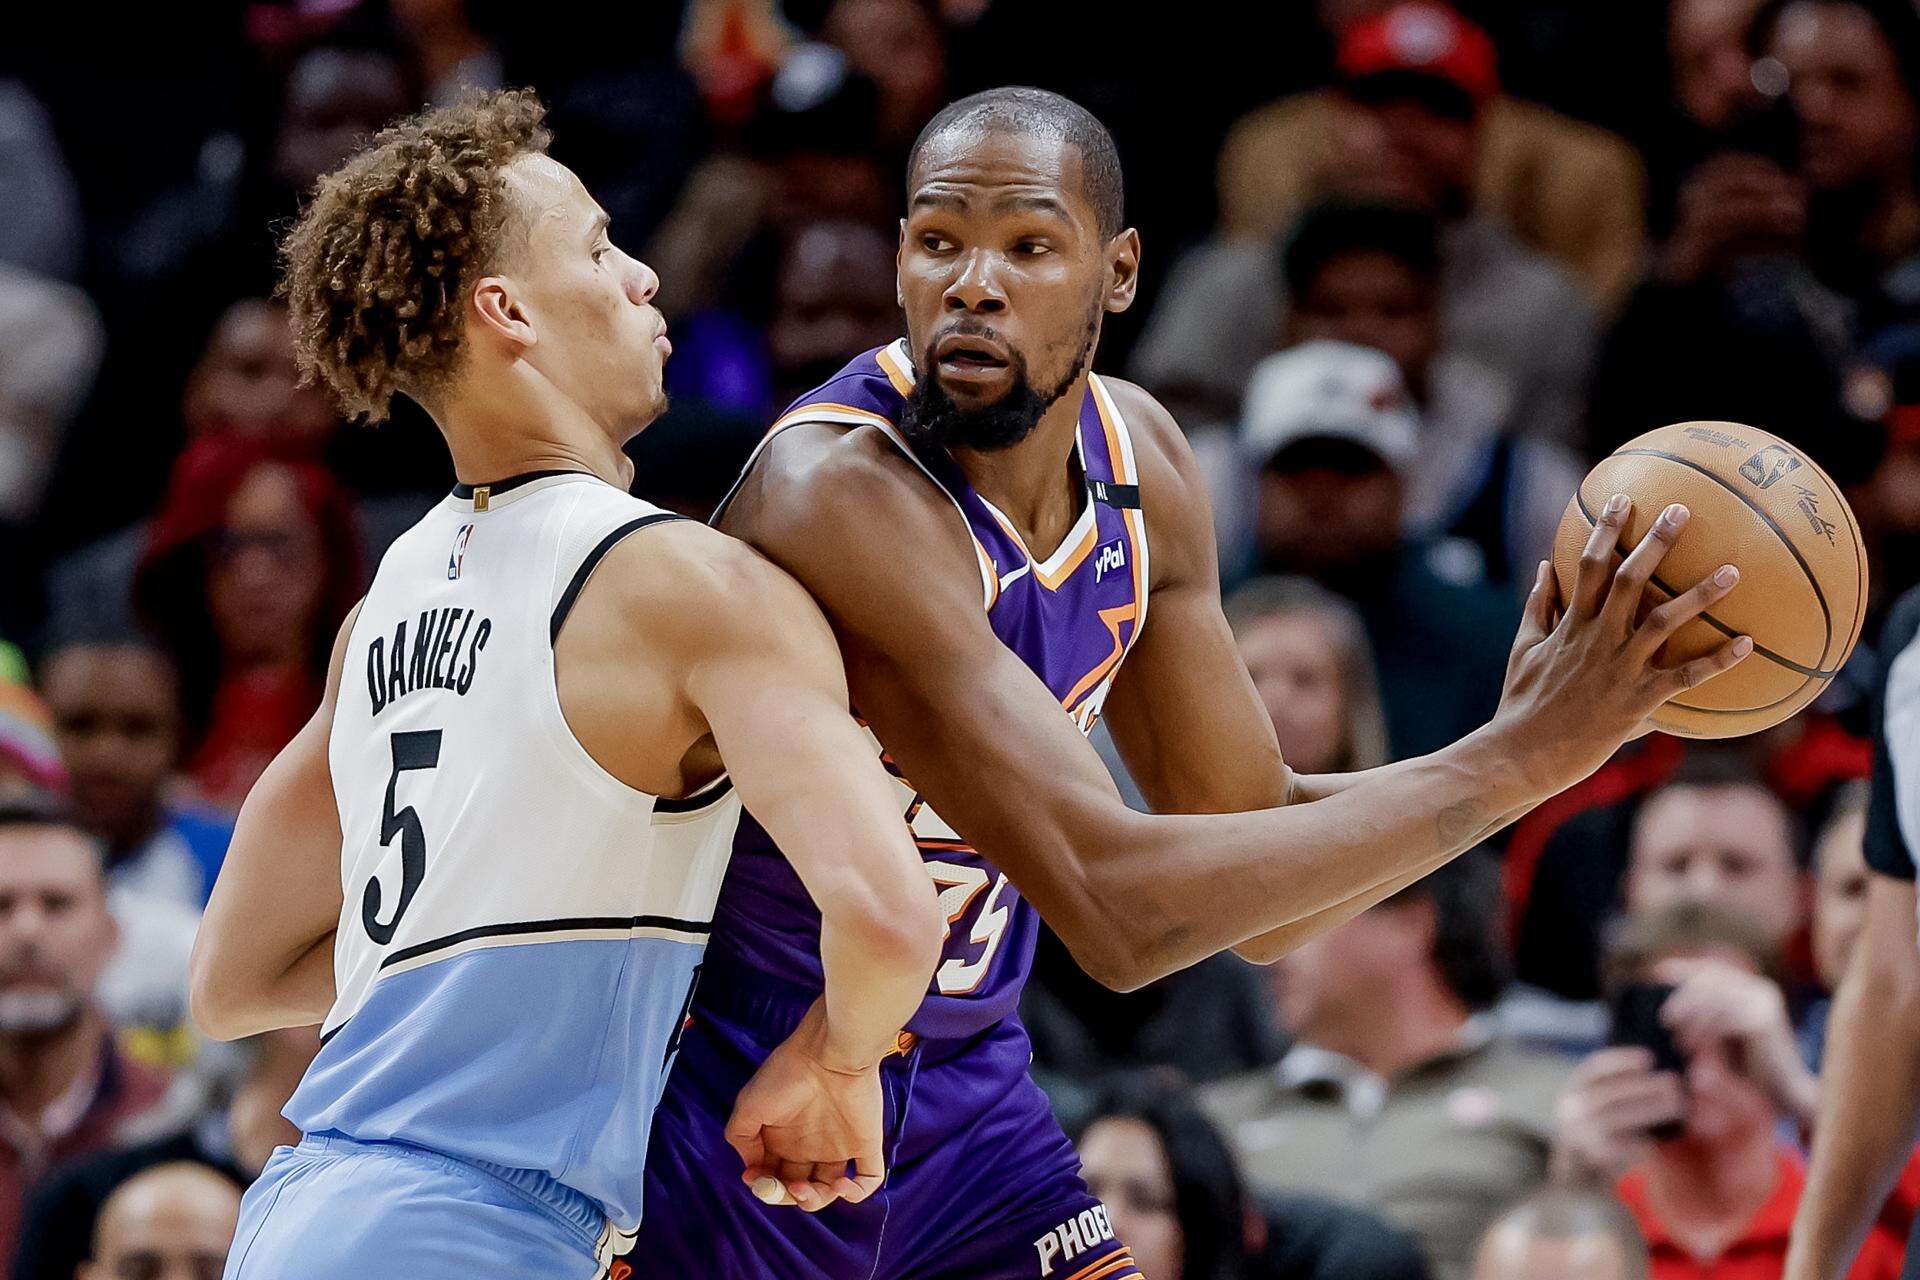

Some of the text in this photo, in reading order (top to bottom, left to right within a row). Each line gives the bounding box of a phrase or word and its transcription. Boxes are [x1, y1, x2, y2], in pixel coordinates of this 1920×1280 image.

[367, 607, 492, 718] DANIELS
[361, 728, 444, 946] 5
[1033, 1204, 1115, 1278] PHOE
